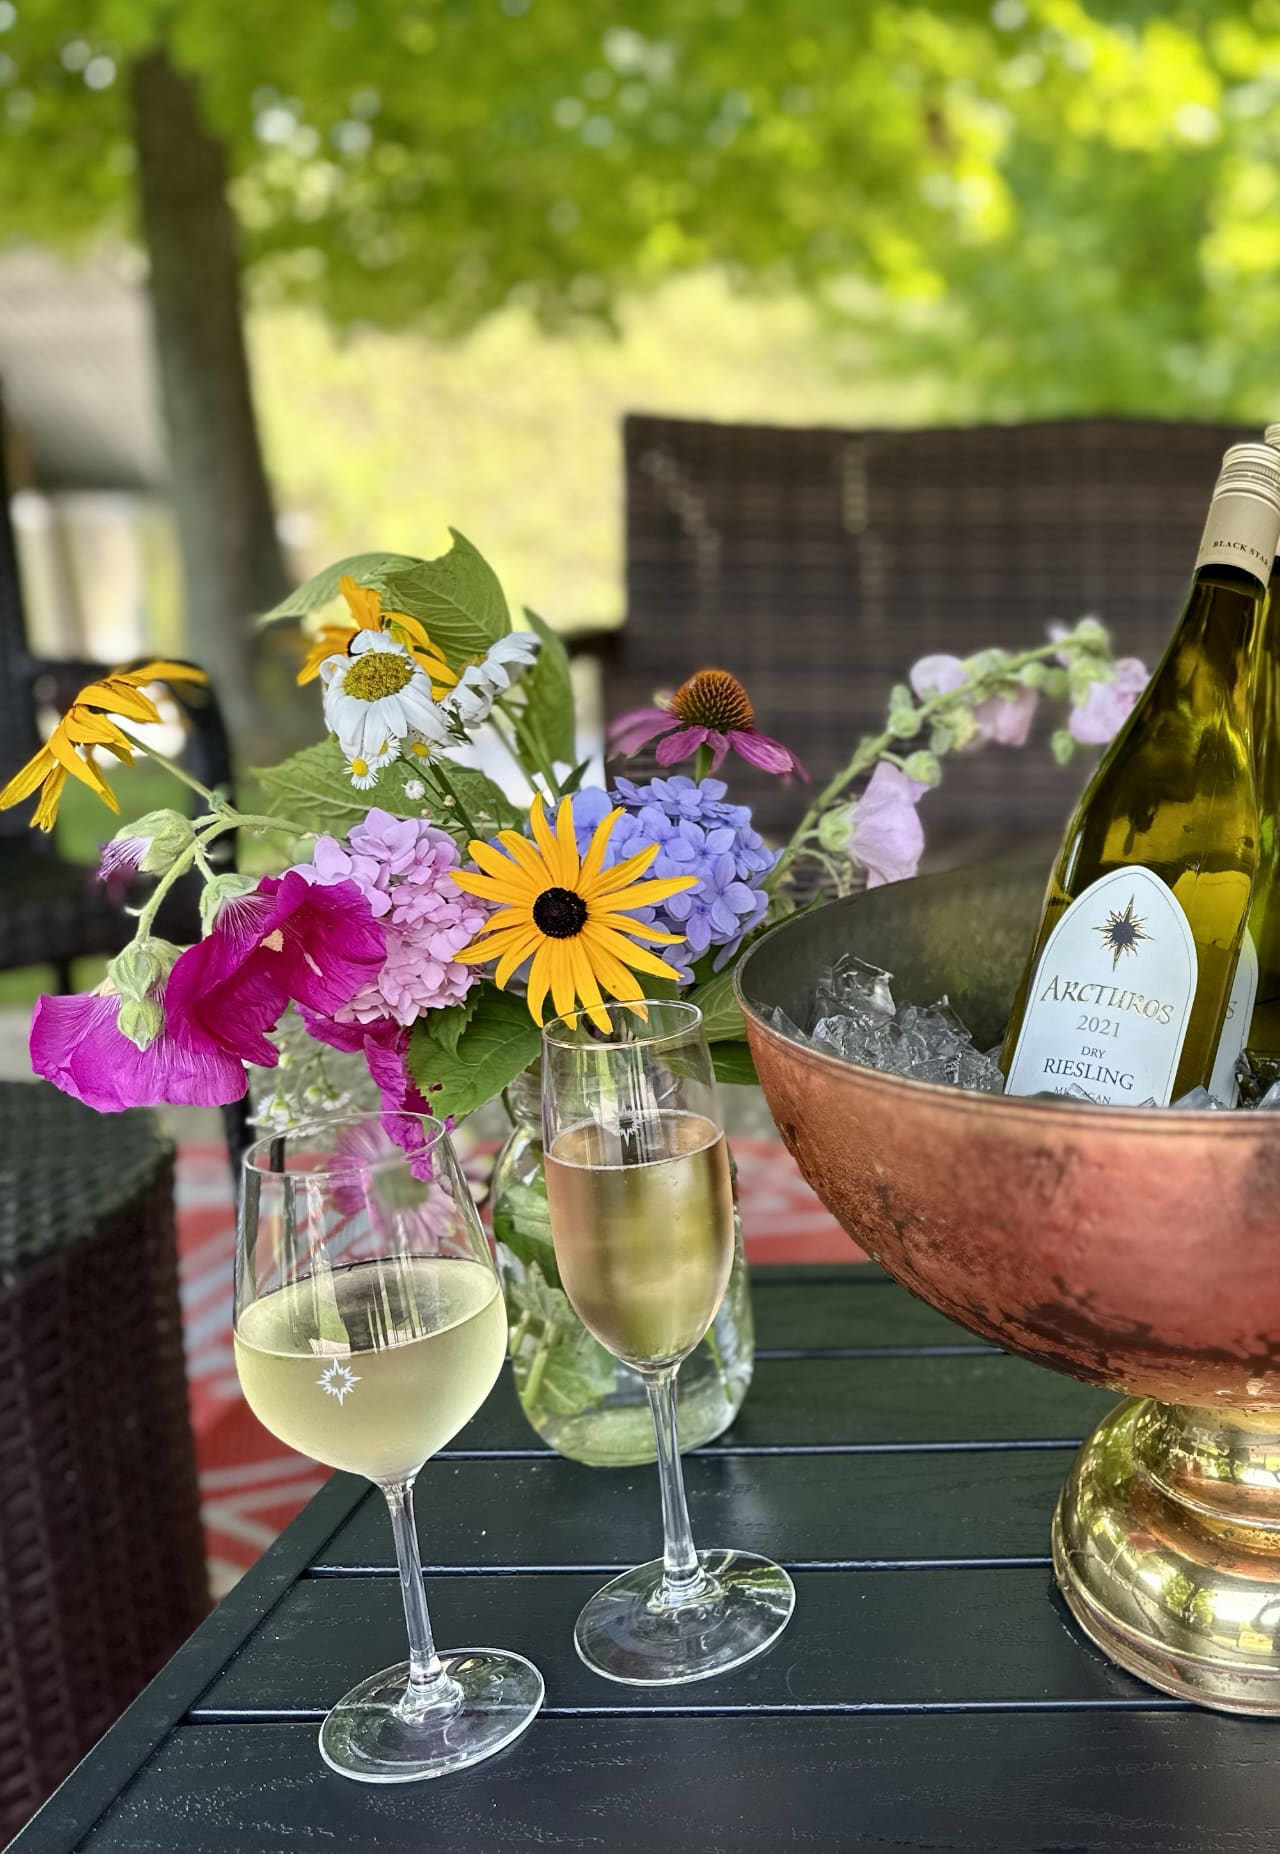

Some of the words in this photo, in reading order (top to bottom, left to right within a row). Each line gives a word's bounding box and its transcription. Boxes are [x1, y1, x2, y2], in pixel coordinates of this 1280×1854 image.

[1213, 540, 1248, 552] BLACK
[1039, 974, 1175, 1026] ARCTUROS
[1075, 1014, 1121, 1038] 2021
[1081, 1045, 1107, 1058] DRY
[1043, 1058, 1135, 1091] RIESLING
